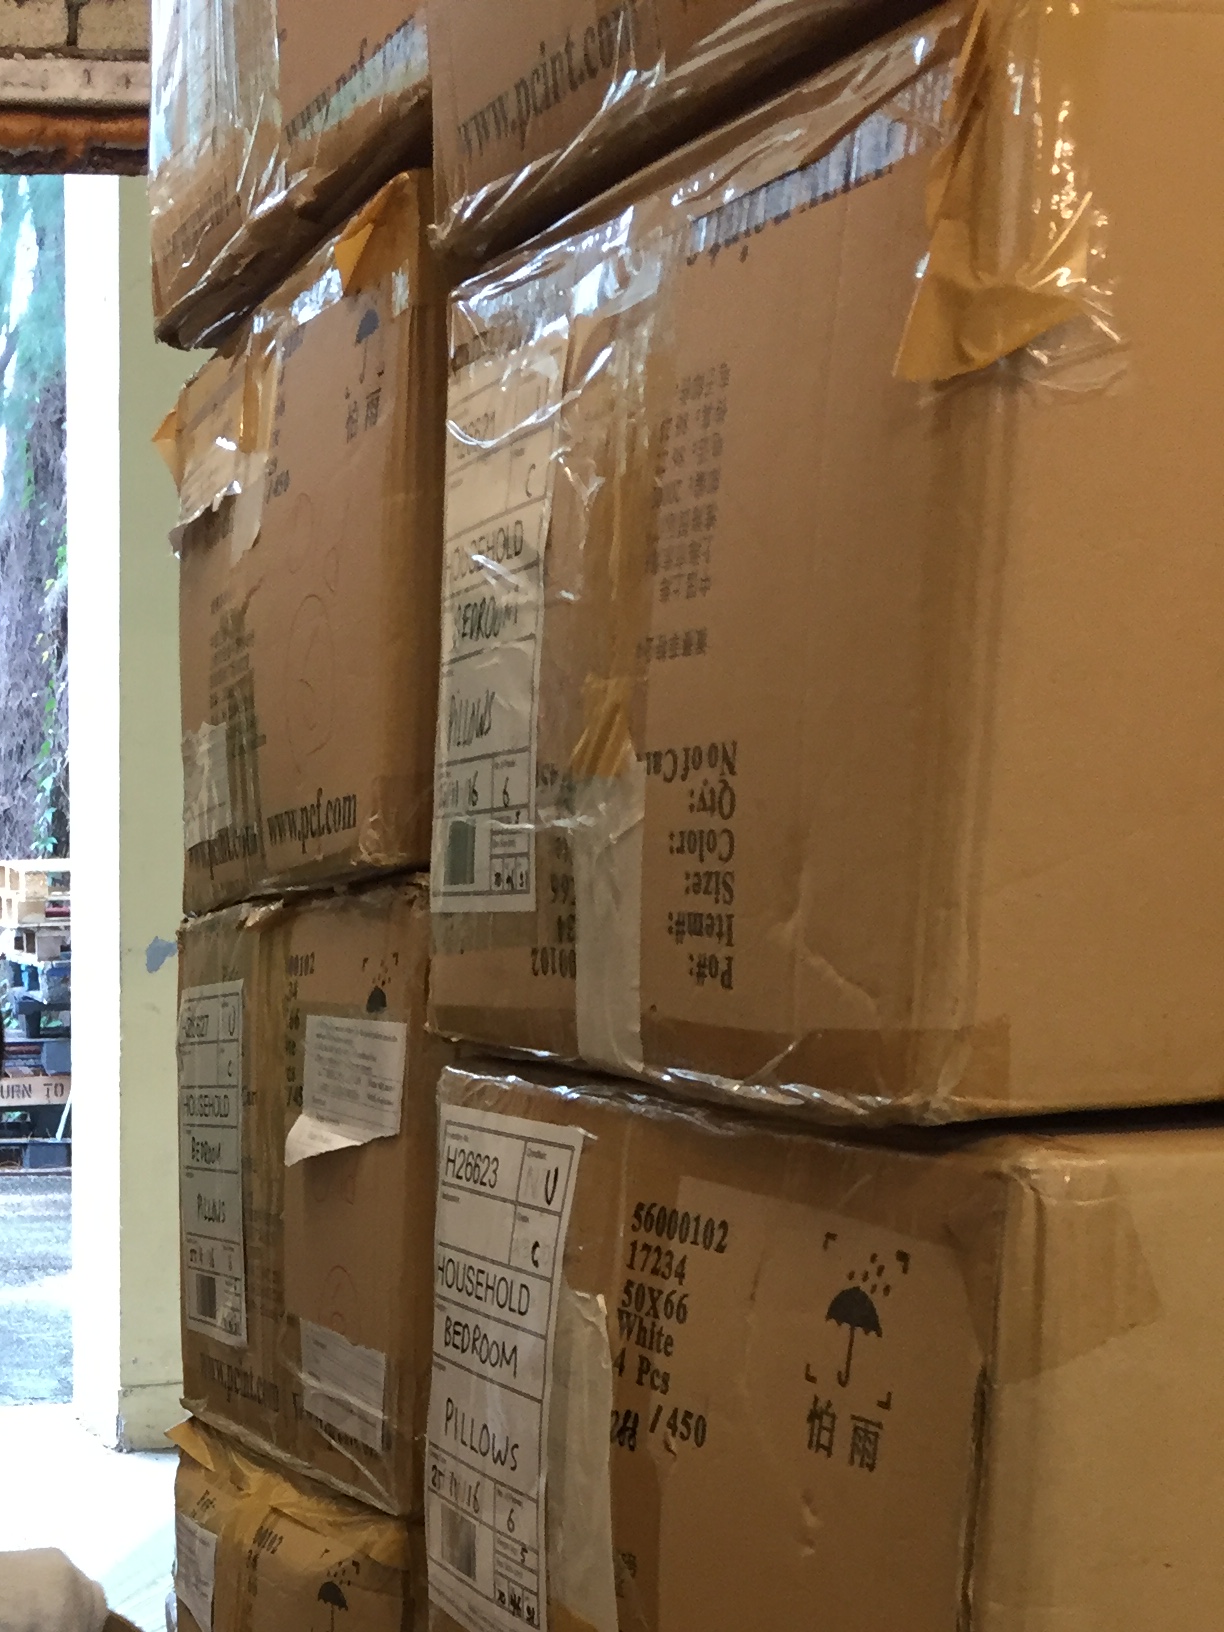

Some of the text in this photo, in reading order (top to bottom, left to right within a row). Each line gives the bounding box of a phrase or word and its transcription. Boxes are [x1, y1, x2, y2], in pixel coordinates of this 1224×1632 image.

[667, 827, 736, 865] Color:
[684, 869, 736, 907] Size:
[666, 909, 736, 949] Item#:
[687, 951, 736, 992] Po#:
[445, 1144, 500, 1190] H26623
[630, 1201, 729, 1254] 56000102
[437, 1255, 531, 1317] HOUSEHOLD
[625, 1239, 688, 1286] 17234
[621, 1278, 689, 1325] 50X66
[443, 1314, 519, 1380] BEDROOM
[617, 1307, 675, 1357] White
[635, 1353, 671, 1396] Pcs
[443, 1396, 520, 1473] PILLOWS
[804, 1395, 884, 1473] 怕雨
